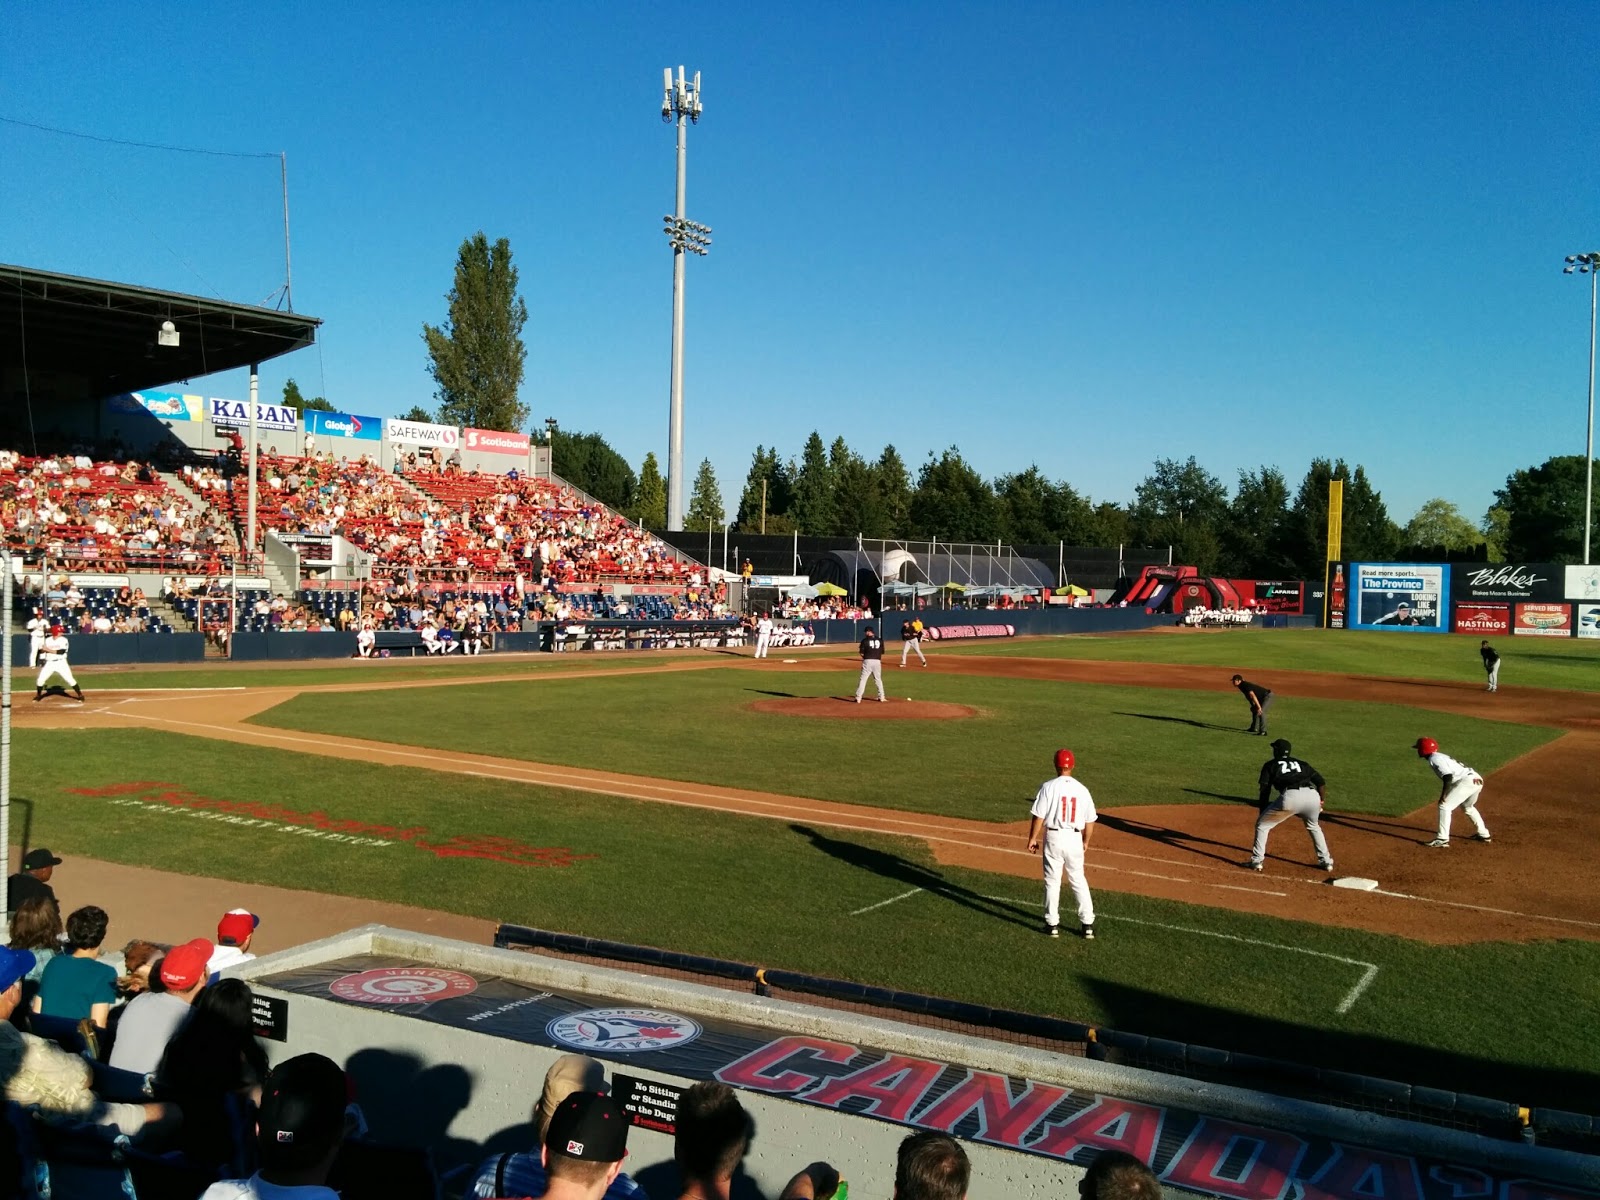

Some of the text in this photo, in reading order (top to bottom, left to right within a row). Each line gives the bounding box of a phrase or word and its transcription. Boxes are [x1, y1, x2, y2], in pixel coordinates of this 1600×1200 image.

[212, 417, 250, 426] PROTECTIV
[325, 419, 354, 431] Global
[345, 429, 354, 437] BC
[390, 424, 442, 441] SAFEWAY
[480, 436, 529, 449] Scotiabank
[1395, 570, 1417, 578] sports.
[1467, 566, 1548, 589] Blakes
[1364, 579, 1381, 588] The
[1382, 579, 1422, 589] Province
[1411, 593, 1437, 601] LOOKING
[1417, 601, 1430, 609] LIKE
[1411, 609, 1436, 617] CHAMPS
[1458, 620, 1507, 629] HASTINGS
[869, 639, 880, 649] 49
[1277, 761, 1302, 774] 24
[1061, 796, 1077, 823] 11
[337, 983, 425, 1003] CANADIANS
[586, 1010, 681, 1023] TORONTO
[556, 1023, 591, 1044] BLUE
[594, 1039, 662, 1049] JAYS
[635, 1082, 680, 1100] No Sitting
[642, 1095, 678, 1111] Standin
[638, 1105, 652, 1115] the
